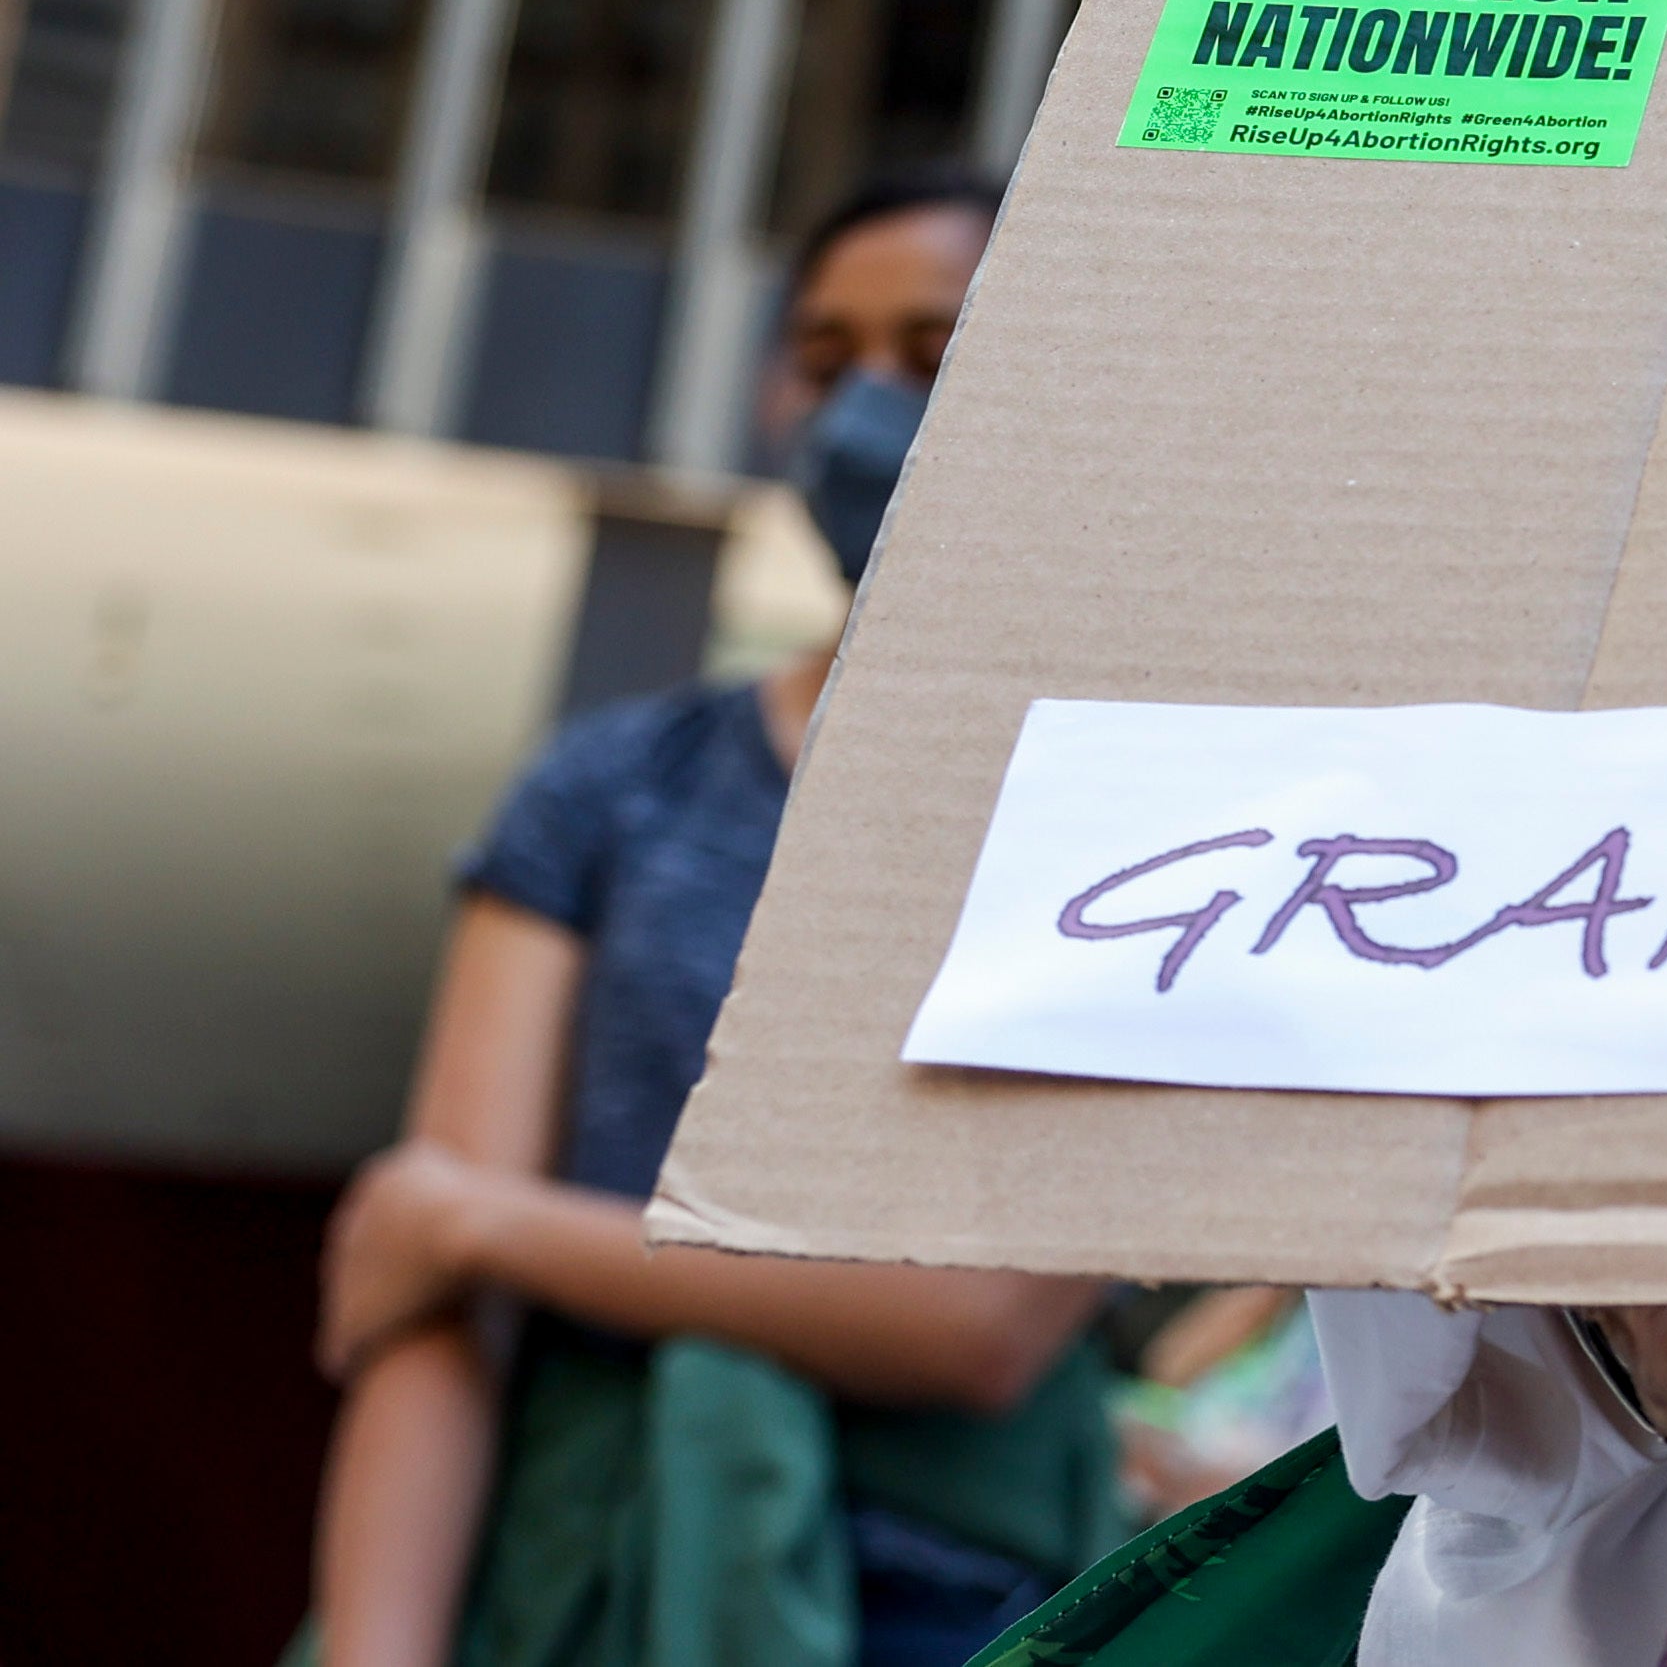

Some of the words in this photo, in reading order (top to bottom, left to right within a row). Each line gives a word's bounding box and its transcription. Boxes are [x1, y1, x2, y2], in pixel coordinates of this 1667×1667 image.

[1191, 1, 1648, 82] NATIONWIDE!
[1250, 89, 1288, 101] SCAN
[1290, 91, 1307, 102] TO
[1309, 93, 1339, 103] SIGN
[1341, 94, 1359, 104] UP
[1361, 95, 1371, 105] &
[1372, 95, 1426, 107] FOLLOW
[1428, 97, 1451, 107] US!
[1245, 105, 1453, 126] #RiseUp4AbortionRights
[1461, 113, 1608, 129] #Green4Abortion
[1229, 124, 1601, 160] RiseUp4AbortionRights.org
